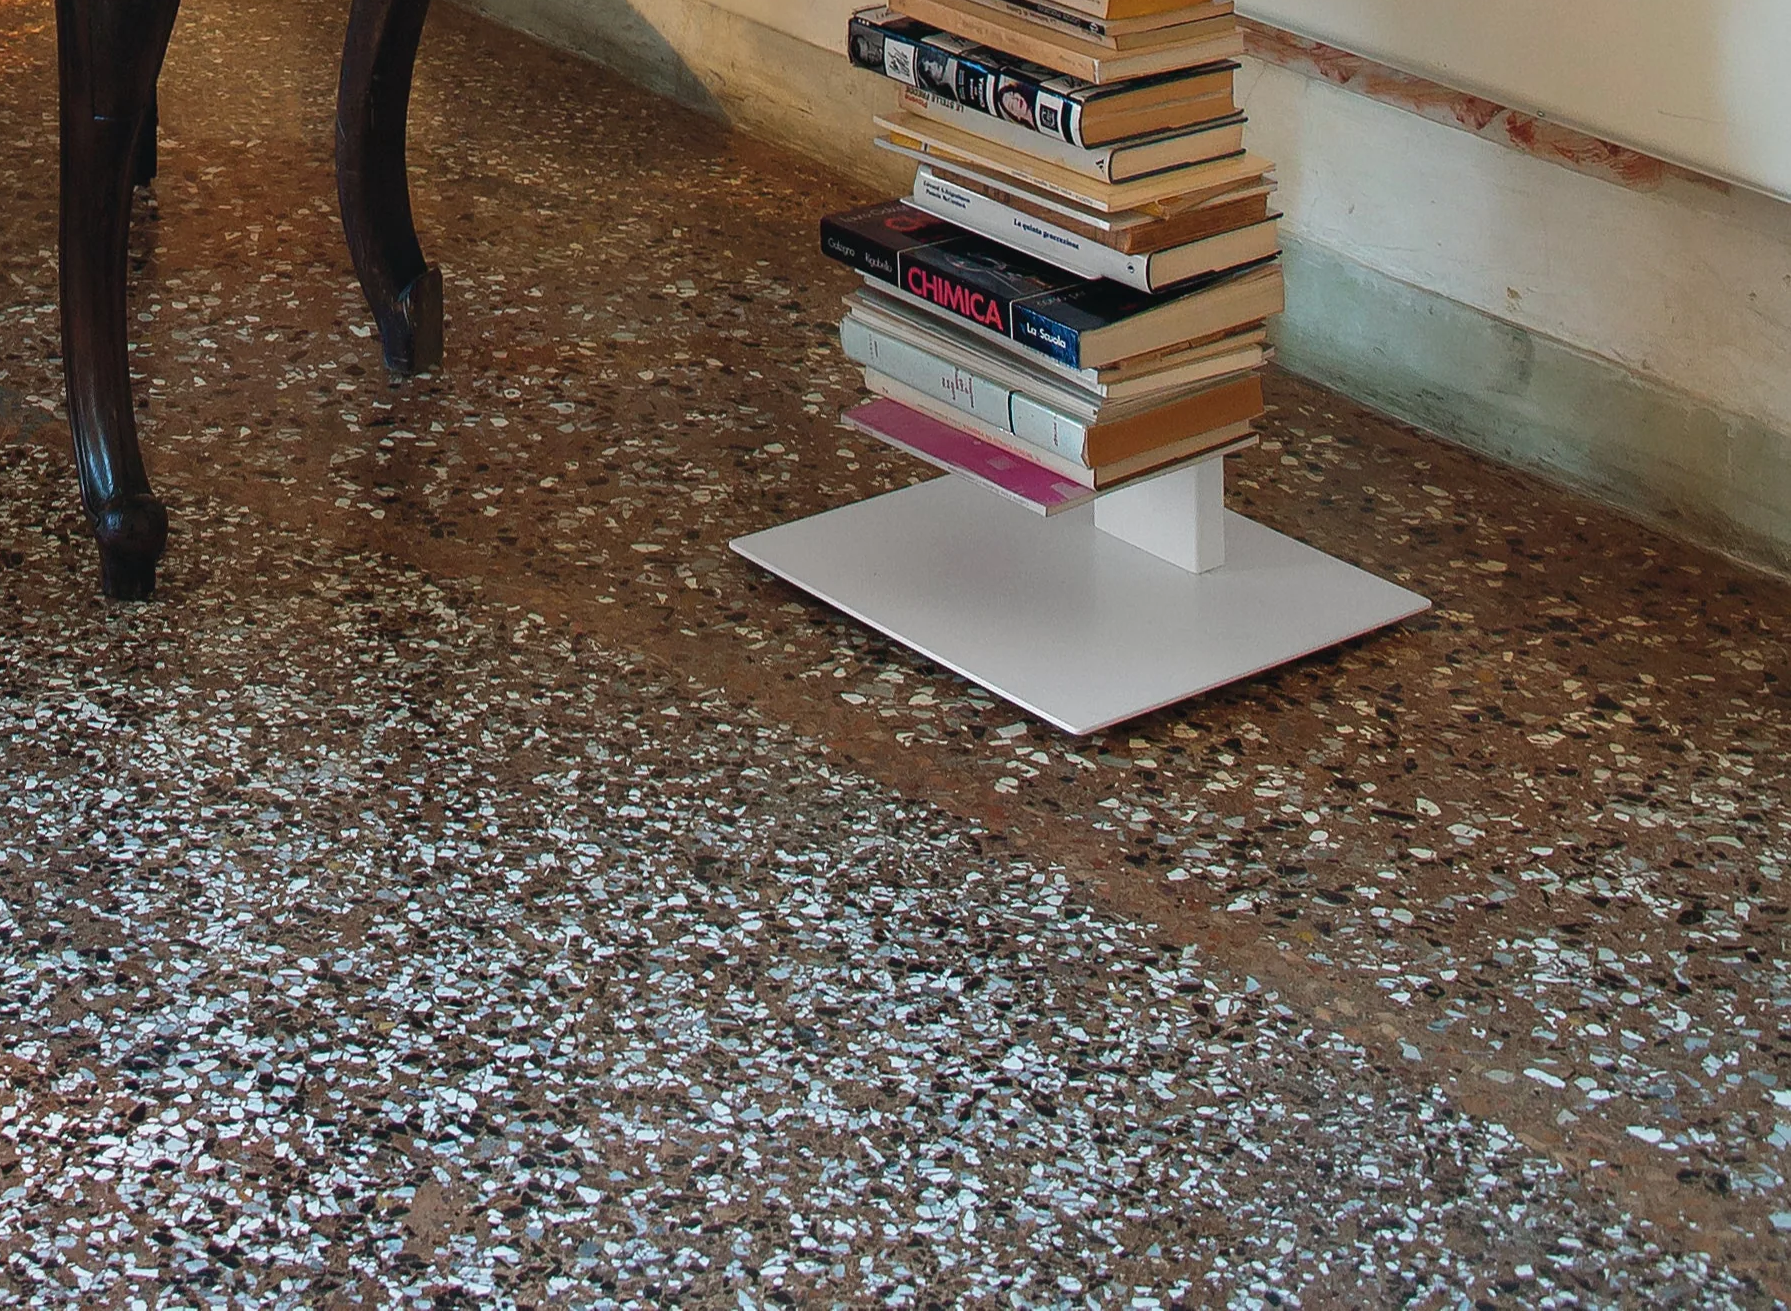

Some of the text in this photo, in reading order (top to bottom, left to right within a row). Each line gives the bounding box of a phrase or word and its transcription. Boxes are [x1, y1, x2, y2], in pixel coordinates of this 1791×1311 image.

[1014, 218, 1021, 227] La
[1022, 221, 1042, 236] quinta
[907, 267, 1004, 331] CHIMICA
[1026, 323, 1066, 349] La Scuola
